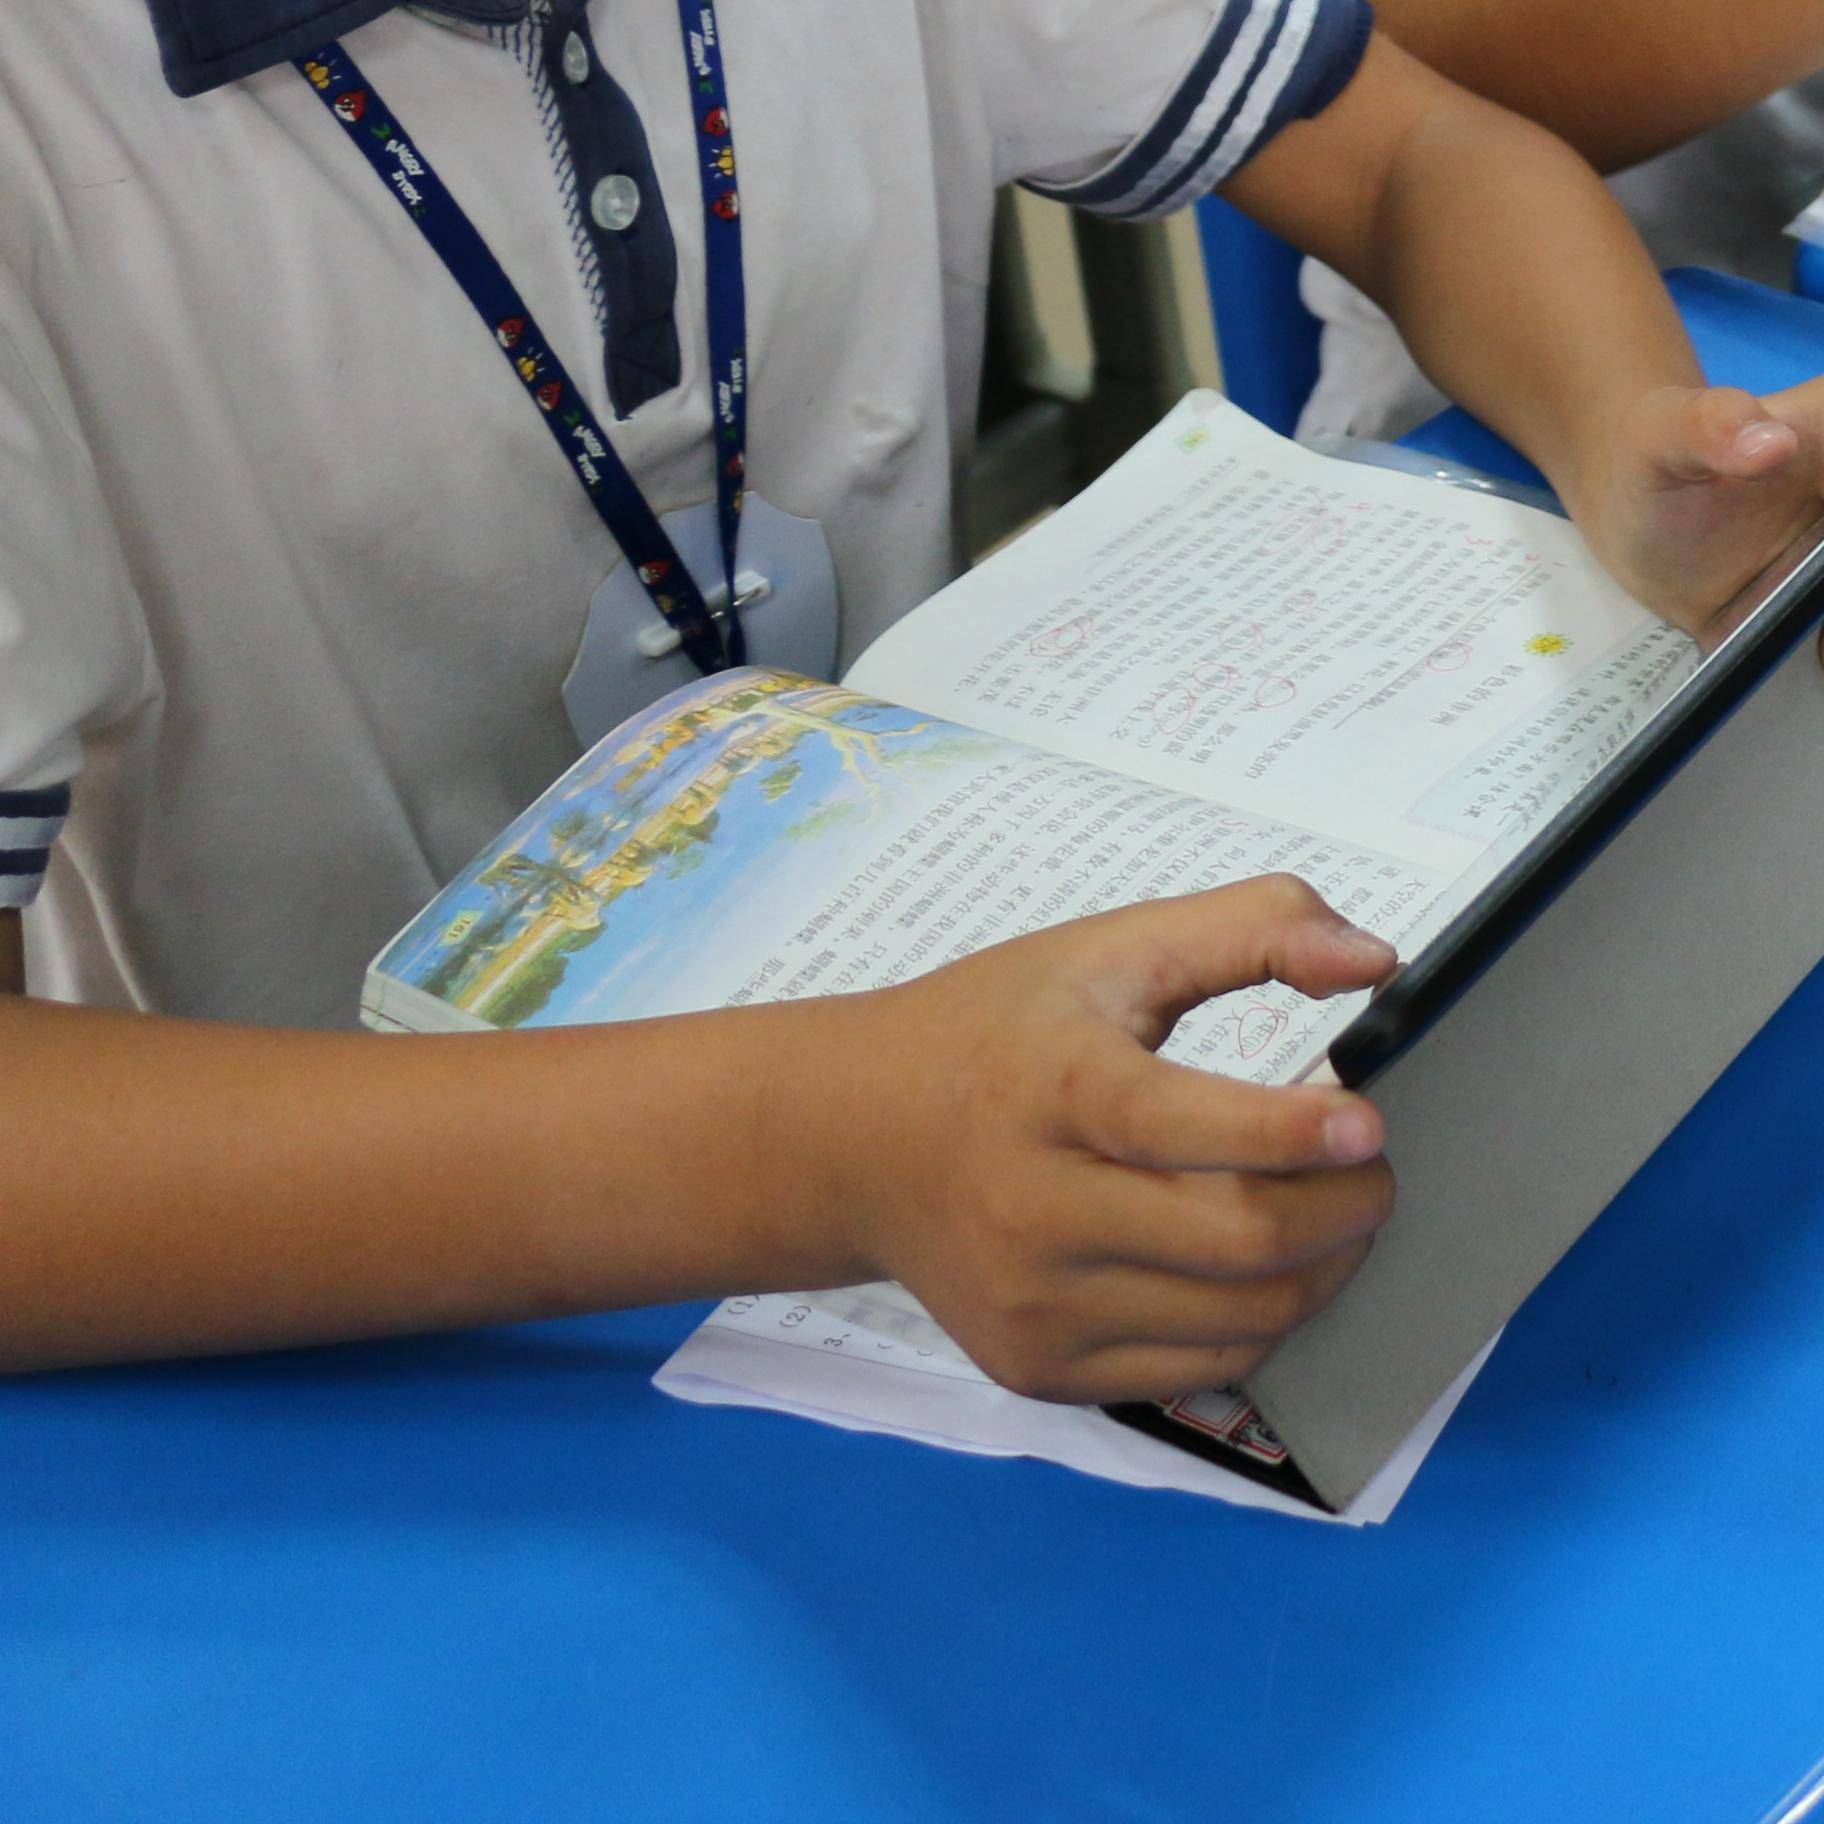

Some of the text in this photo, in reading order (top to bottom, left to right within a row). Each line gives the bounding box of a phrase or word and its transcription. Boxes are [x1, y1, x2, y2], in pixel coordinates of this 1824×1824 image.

[1131, 821, 1233, 911] 非洲不仅植物
[1360, 873, 1428, 938] 天空的云
[779, 1303, 812, 1328] (2)
